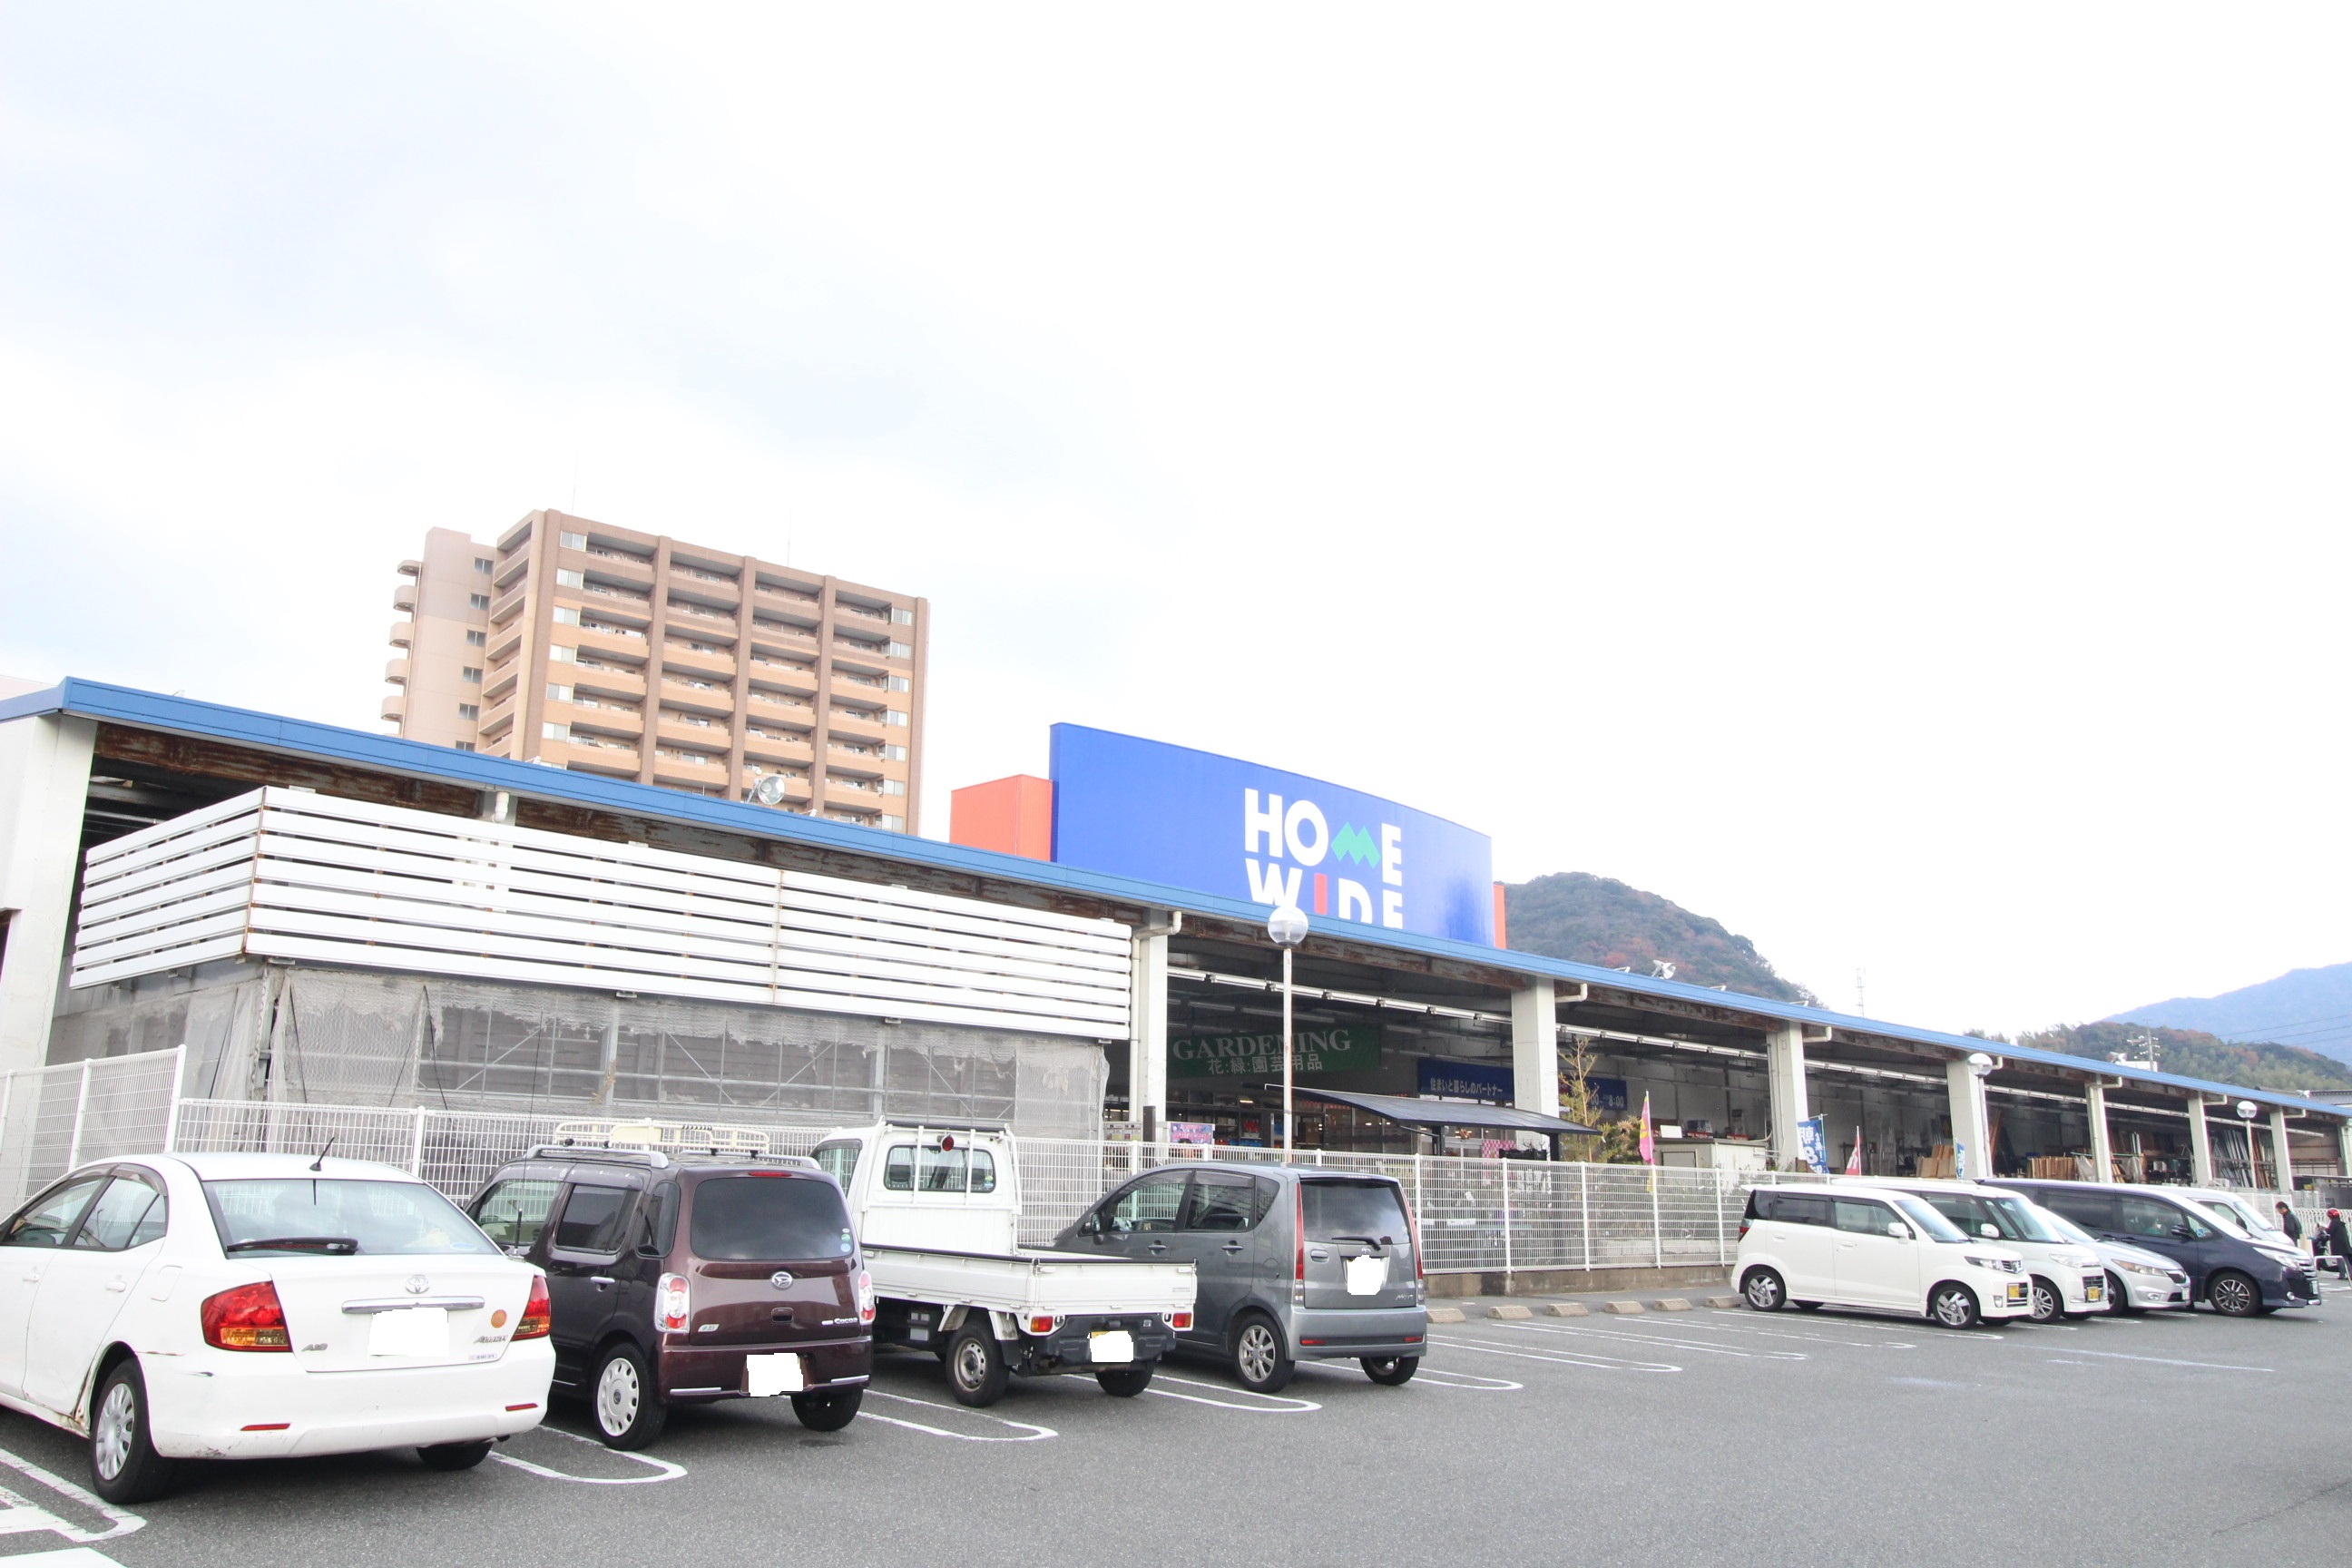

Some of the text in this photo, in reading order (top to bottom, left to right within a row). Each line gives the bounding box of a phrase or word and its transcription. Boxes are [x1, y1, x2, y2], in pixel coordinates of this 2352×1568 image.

[1244, 788, 1402, 887] HOME
[1244, 858, 1403, 928] WIDE
[1172, 1029, 1351, 1060] GARDENING
[1430, 1077, 1503, 1096] 住まいと暮らしのパートナー
